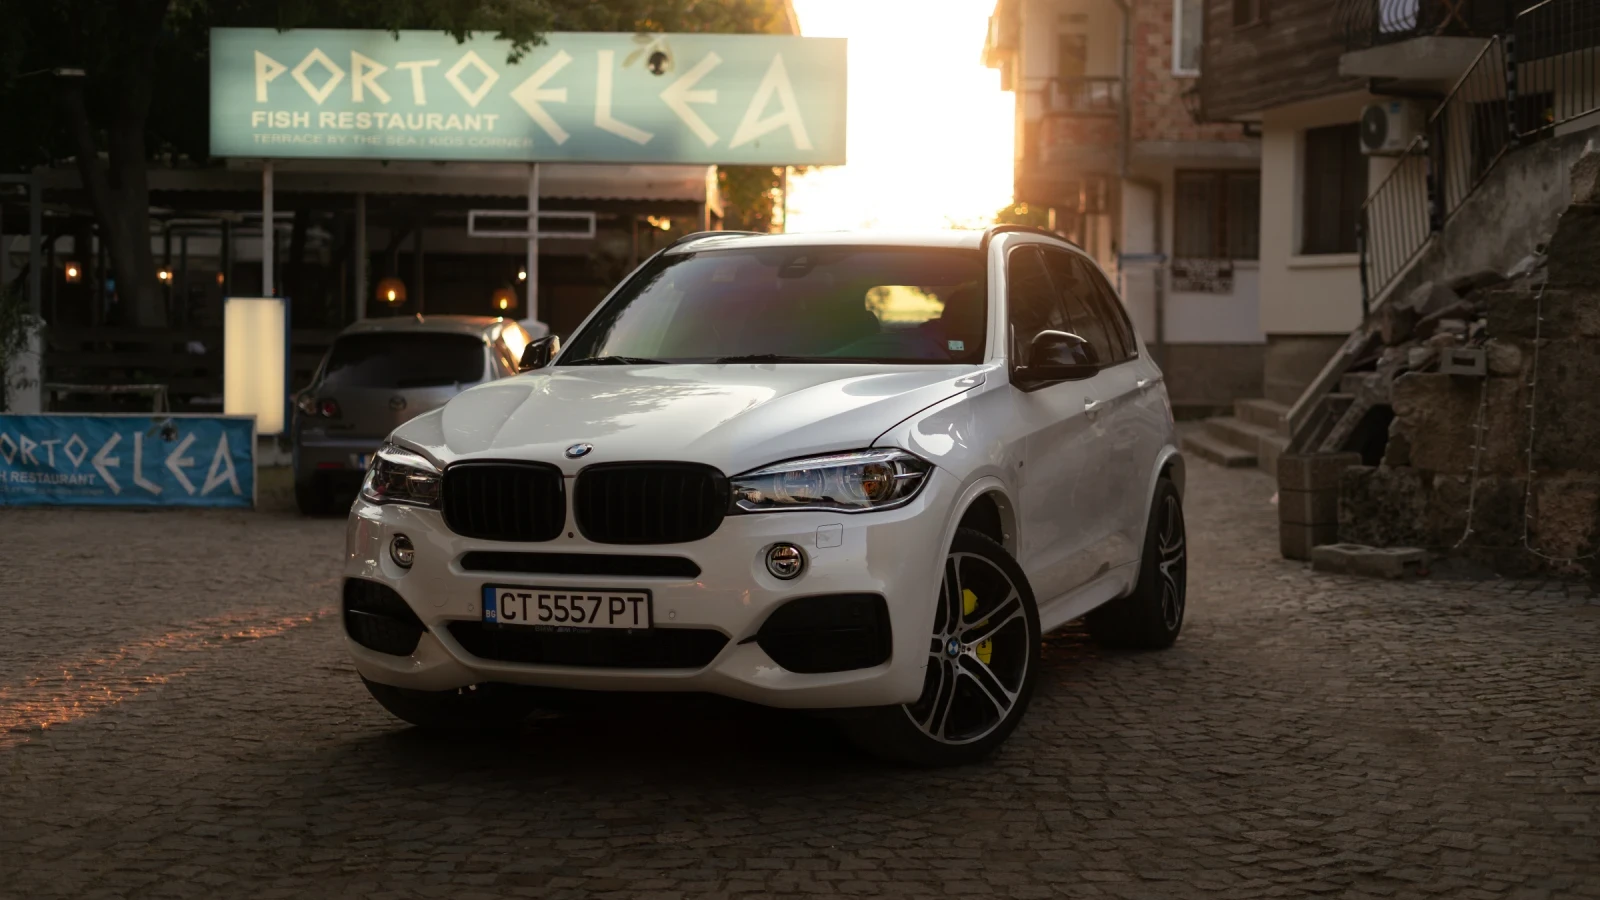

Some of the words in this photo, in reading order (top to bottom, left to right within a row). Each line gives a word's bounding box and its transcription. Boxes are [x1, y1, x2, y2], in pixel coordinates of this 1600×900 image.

[254, 47, 500, 108] PORTO
[509, 49, 813, 150] ELEA
[251, 110, 311, 129] FISH
[319, 111, 499, 131] RESTAURANT
[252, 133, 323, 145] TERRACE
[327, 134, 348, 145] BY
[352, 135, 381, 146] THE
[386, 135, 417, 147] SEA
[429, 136, 463, 148] KIDS
[92, 432, 242, 495] ELEA
[10, 470, 97, 486] RESTAURANT
[485, 609, 496, 618] BG
[501, 592, 532, 621] CT
[538, 595, 603, 624] 5557
[608, 596, 644, 625] PT
